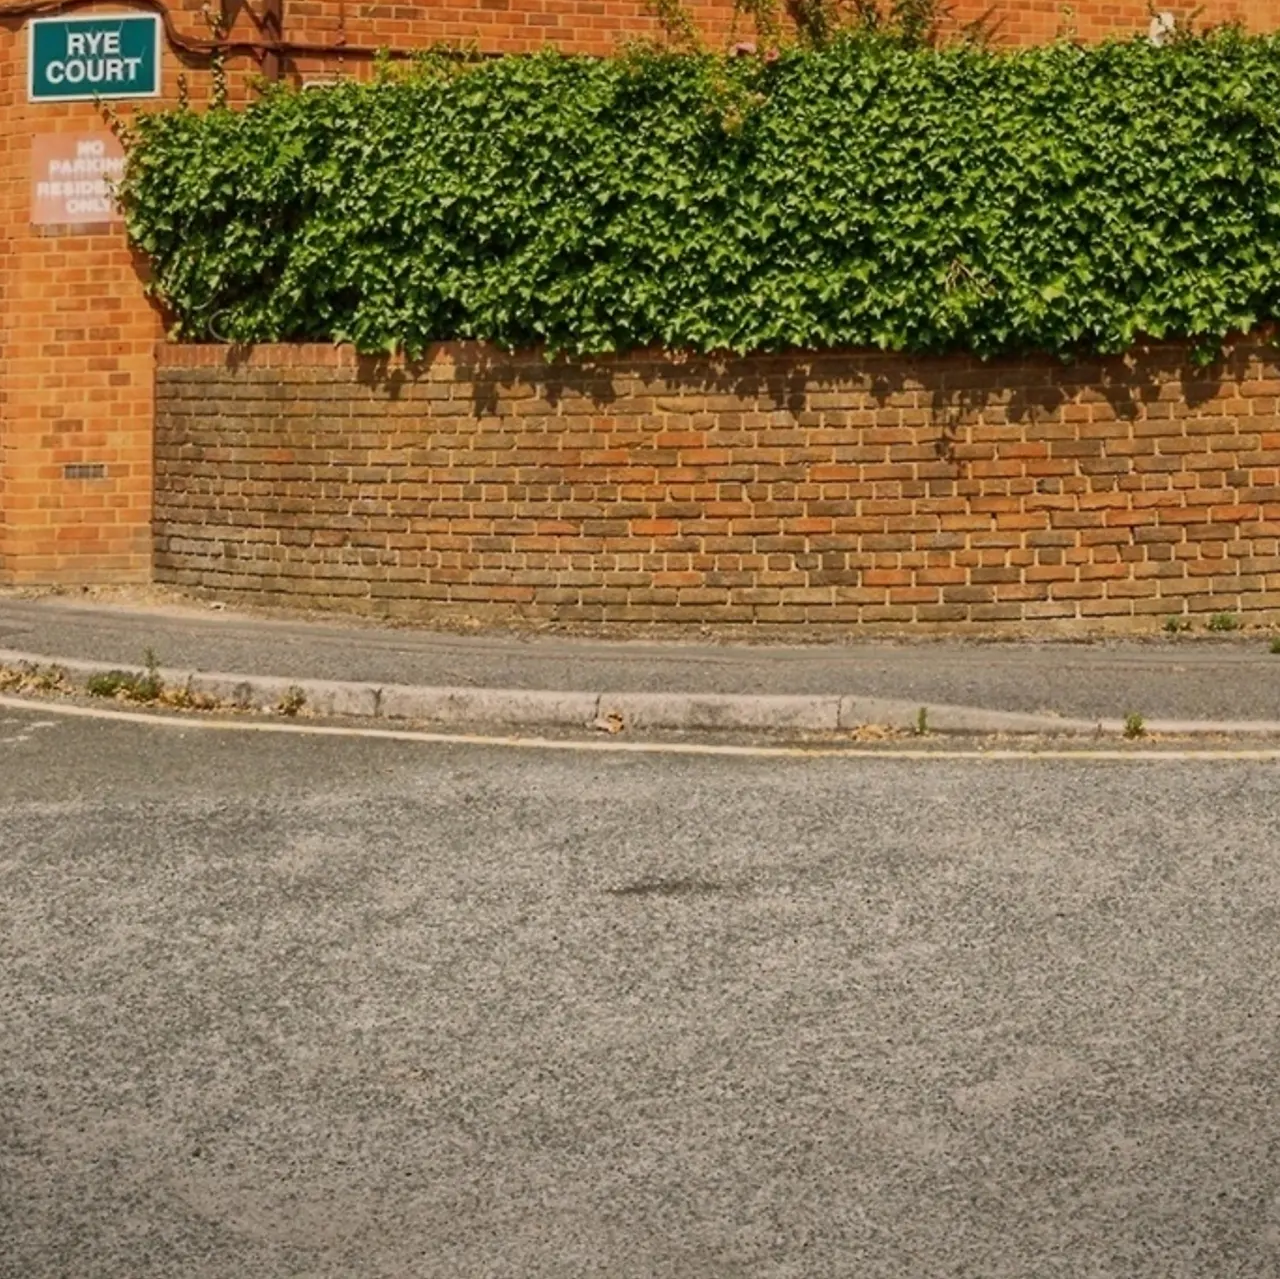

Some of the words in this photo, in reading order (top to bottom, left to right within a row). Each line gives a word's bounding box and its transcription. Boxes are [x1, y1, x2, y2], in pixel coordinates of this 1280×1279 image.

[68, 31, 119, 55] RYE
[46, 58, 141, 84] COURT
[77, 140, 105, 157] NO
[66, 198, 111, 214] ONLY
